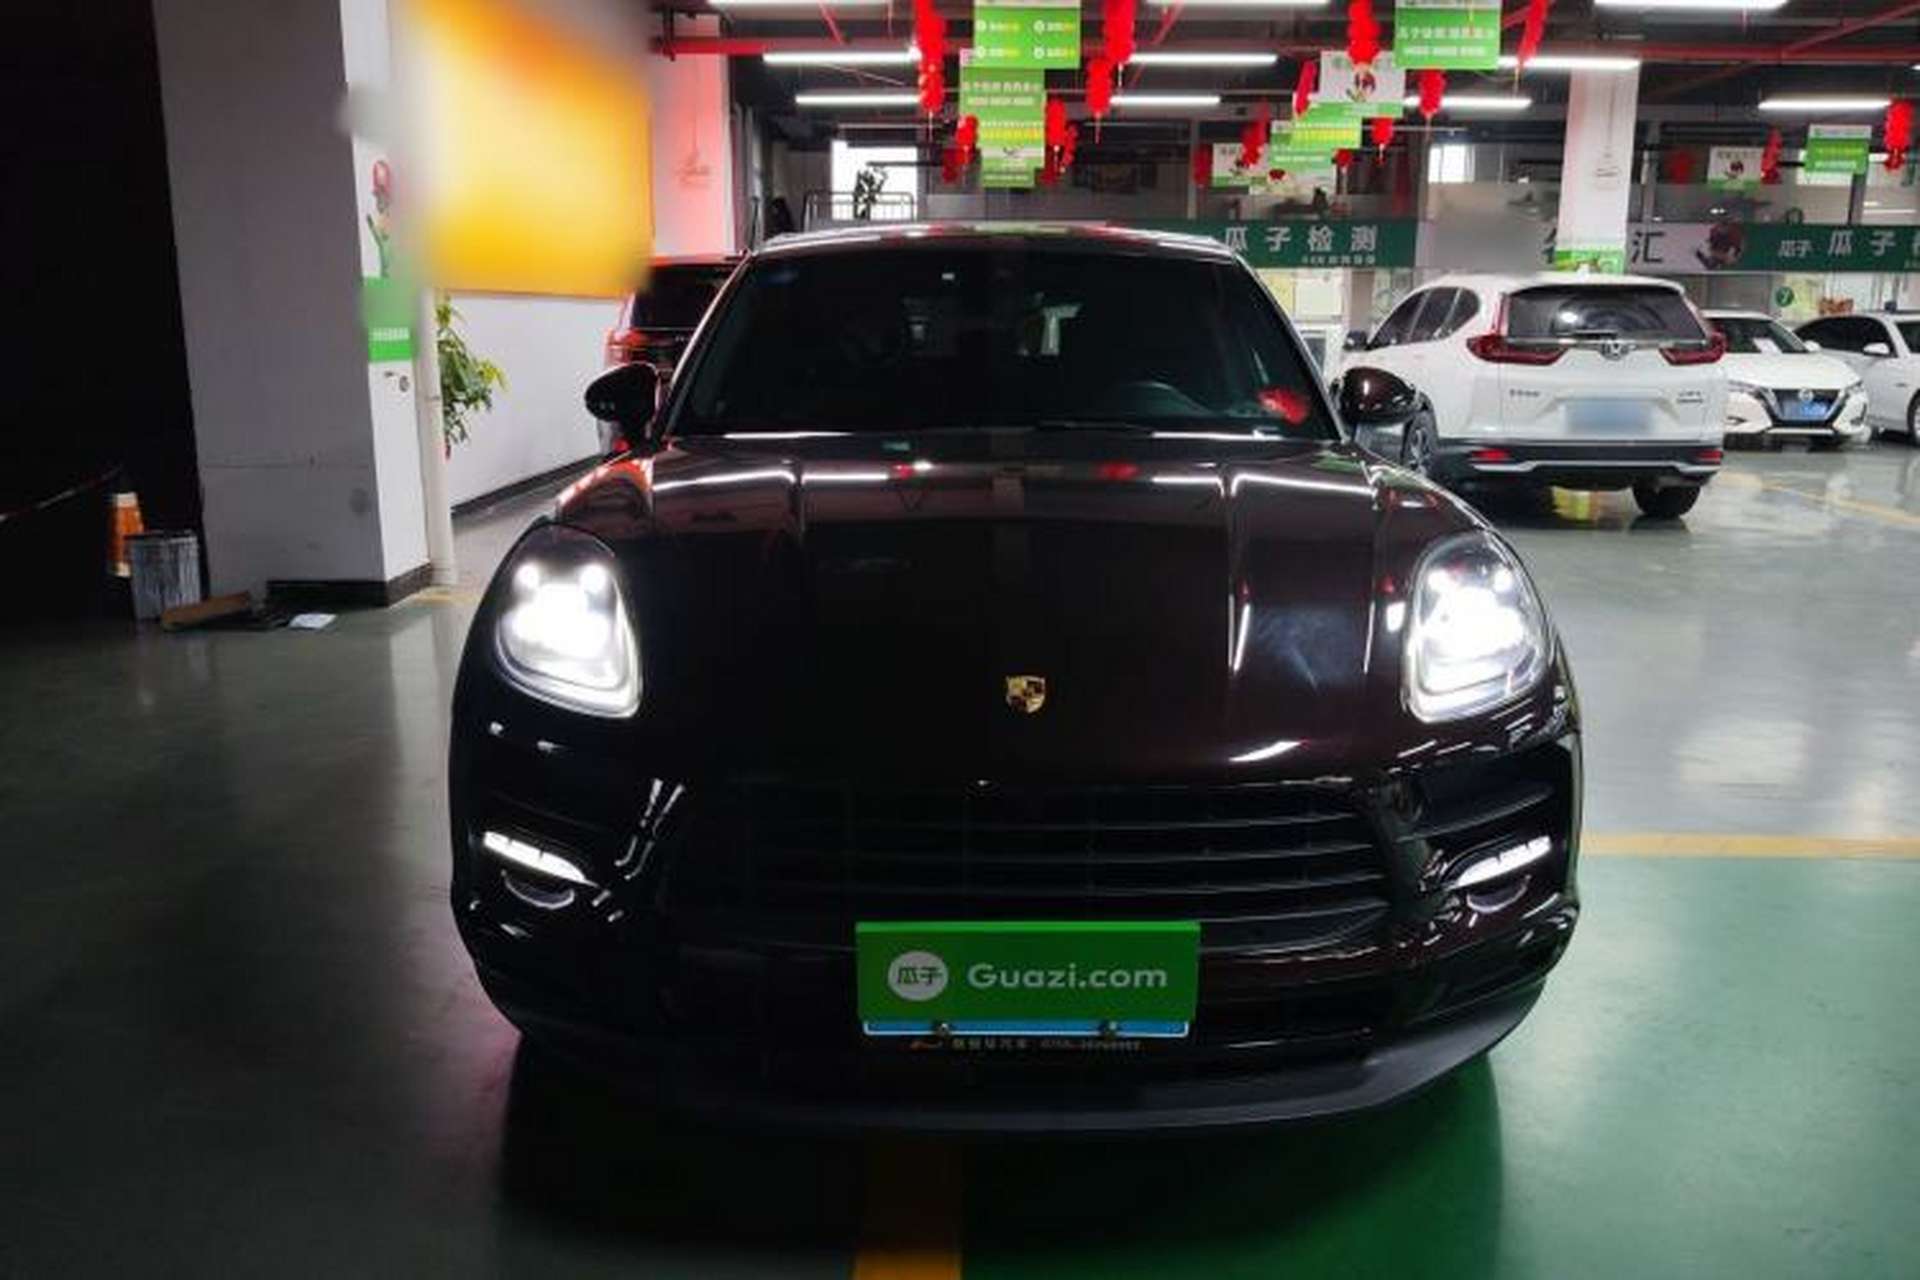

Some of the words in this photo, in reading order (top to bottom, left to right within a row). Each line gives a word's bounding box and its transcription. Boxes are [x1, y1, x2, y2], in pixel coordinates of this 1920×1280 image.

[1225, 225, 1378, 253] 瓜子检测
[898, 966, 943, 987] 瓜子
[967, 963, 1168, 989] Guazi.com
